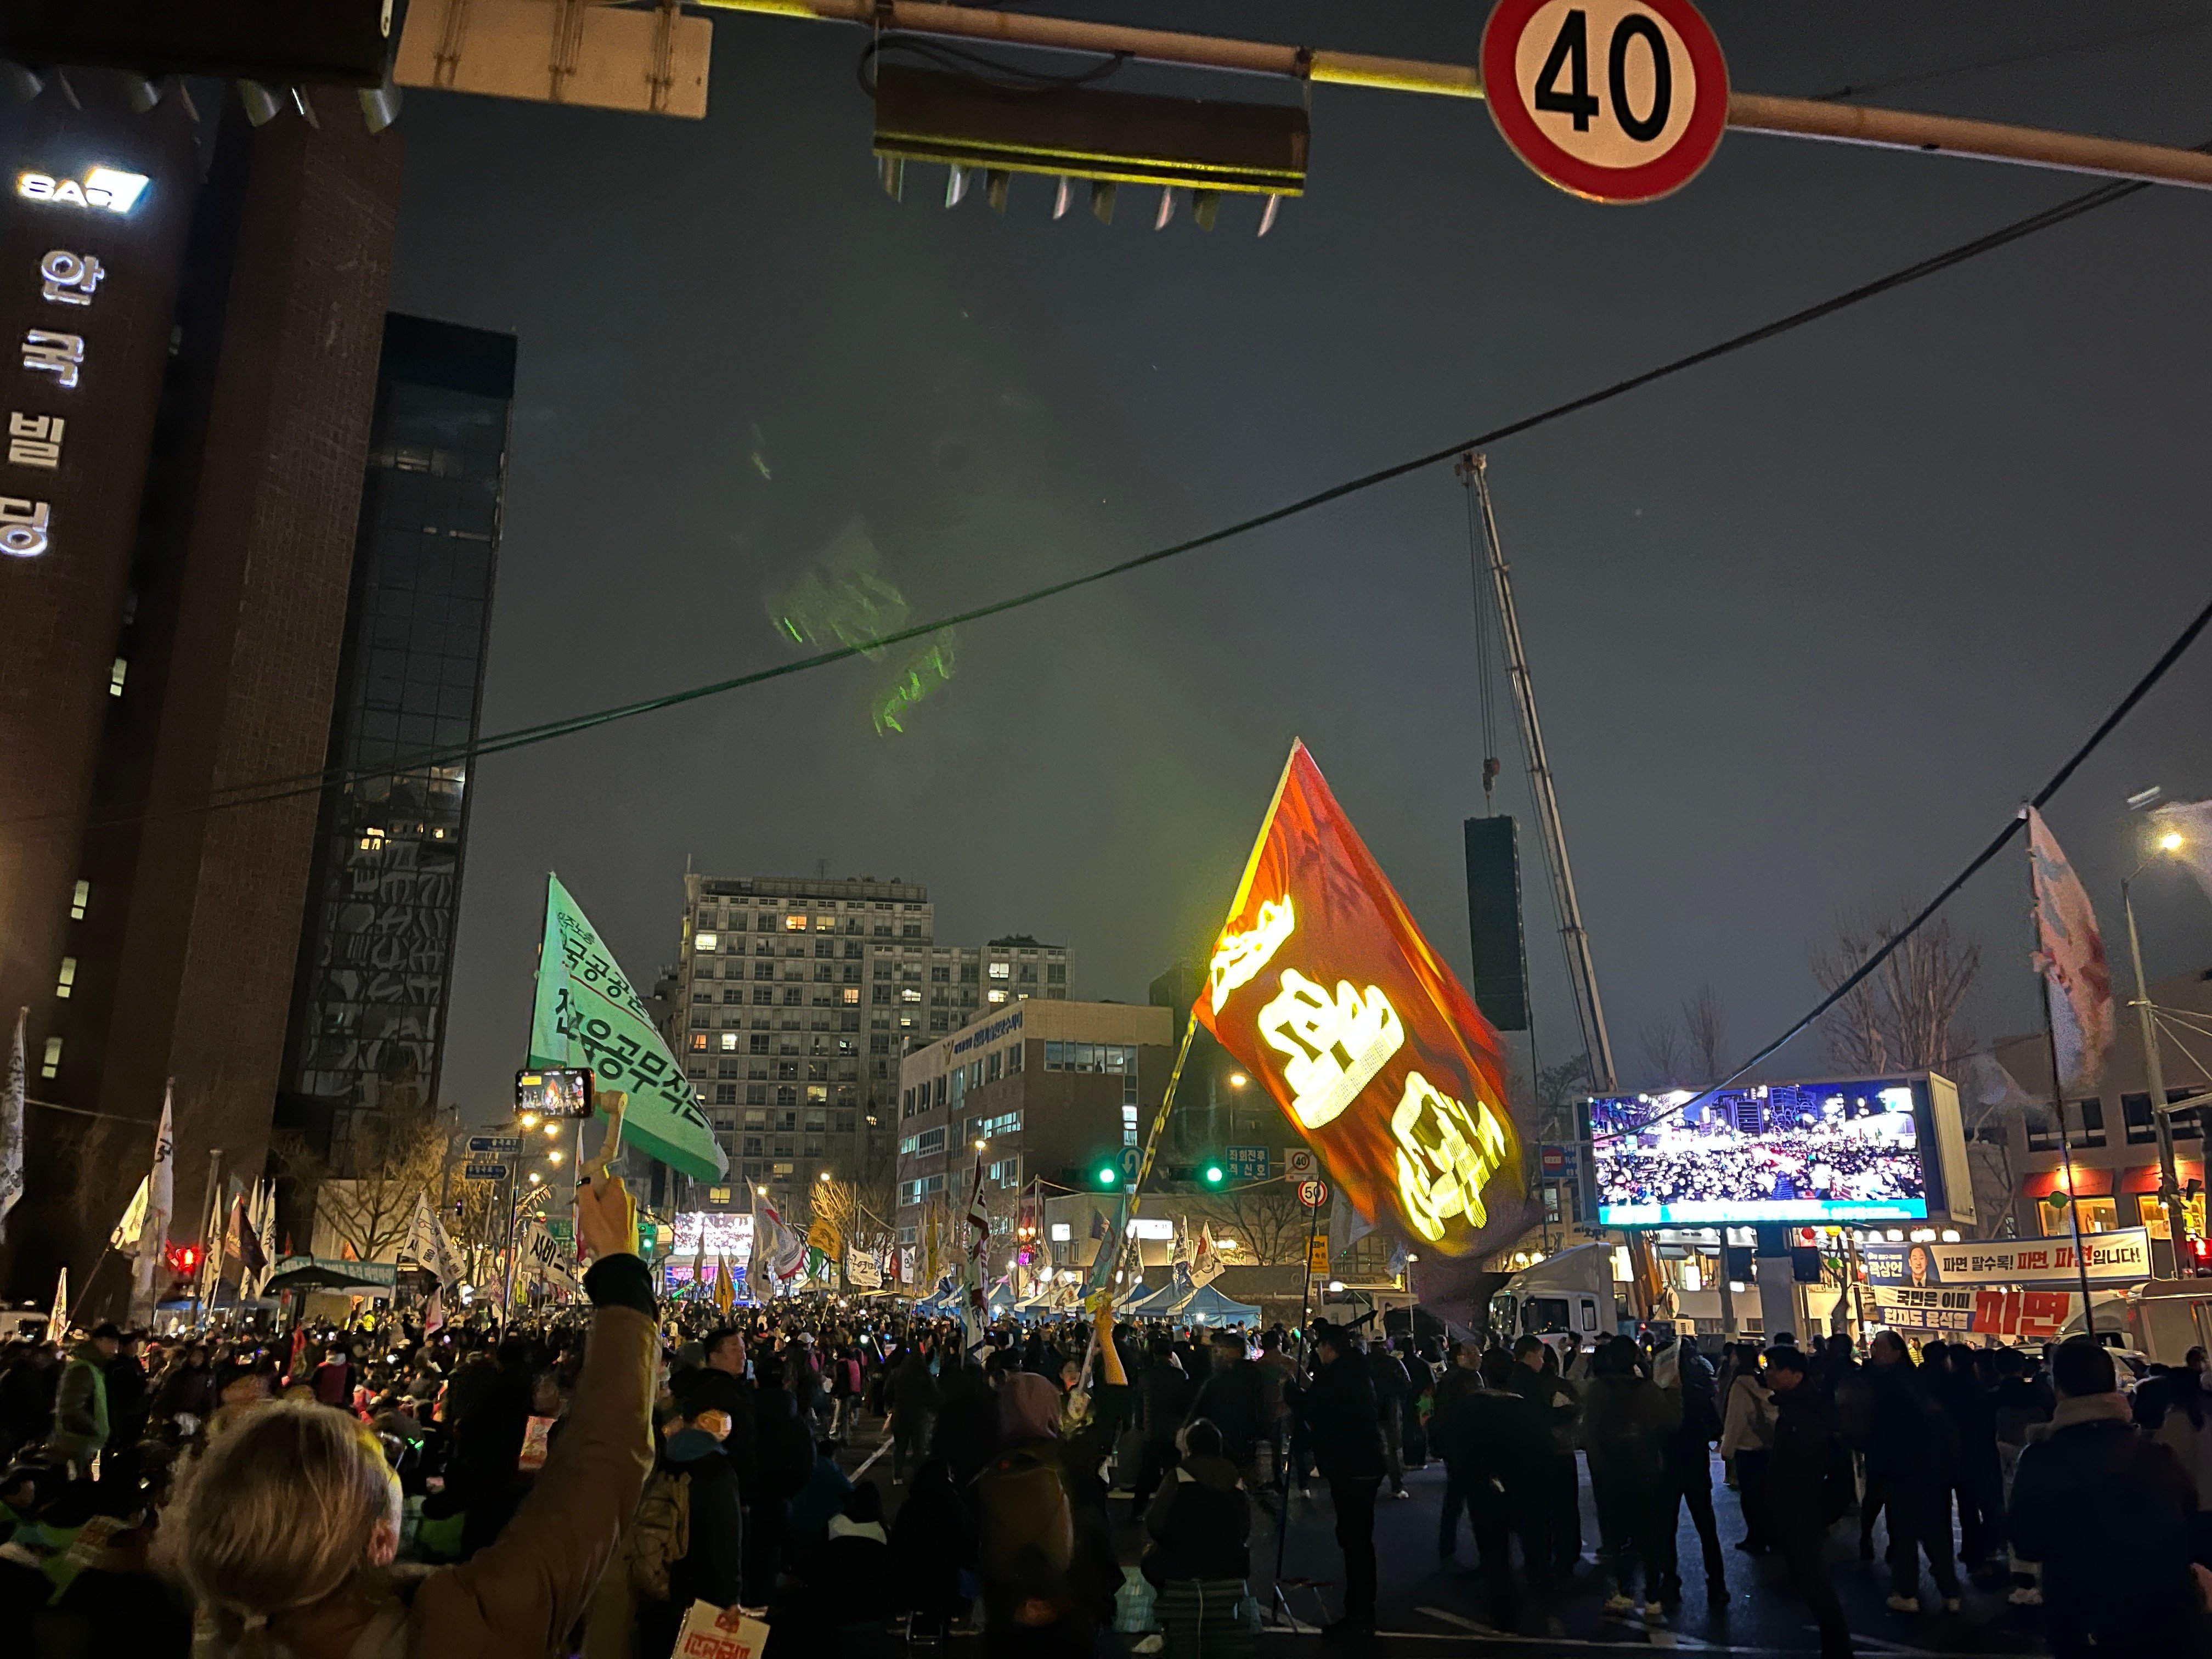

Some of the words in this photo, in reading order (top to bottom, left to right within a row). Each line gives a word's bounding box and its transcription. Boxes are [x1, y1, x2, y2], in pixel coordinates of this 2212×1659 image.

[1534, 9, 1672, 142] 40
[0, 249, 104, 557] 안국빌딩
[1229, 1149, 1266, 1162] 좌회전후
[1296, 1156, 1307, 1166] 40
[1305, 1186, 1321, 1199] 50
[1868, 1261, 1903, 1278] 곽상언
[1943, 1256, 1967, 1272] 파면
[1972, 1255, 2013, 1271] 팔수록!
[1897, 1290, 1938, 1307] 국민은
[1942, 1290, 1970, 1308] 이미
[1884, 1307, 1923, 1327] 헌재도
[1926, 1311, 1968, 1329] 윤석열
[1974, 1291, 2070, 1335] 파면
